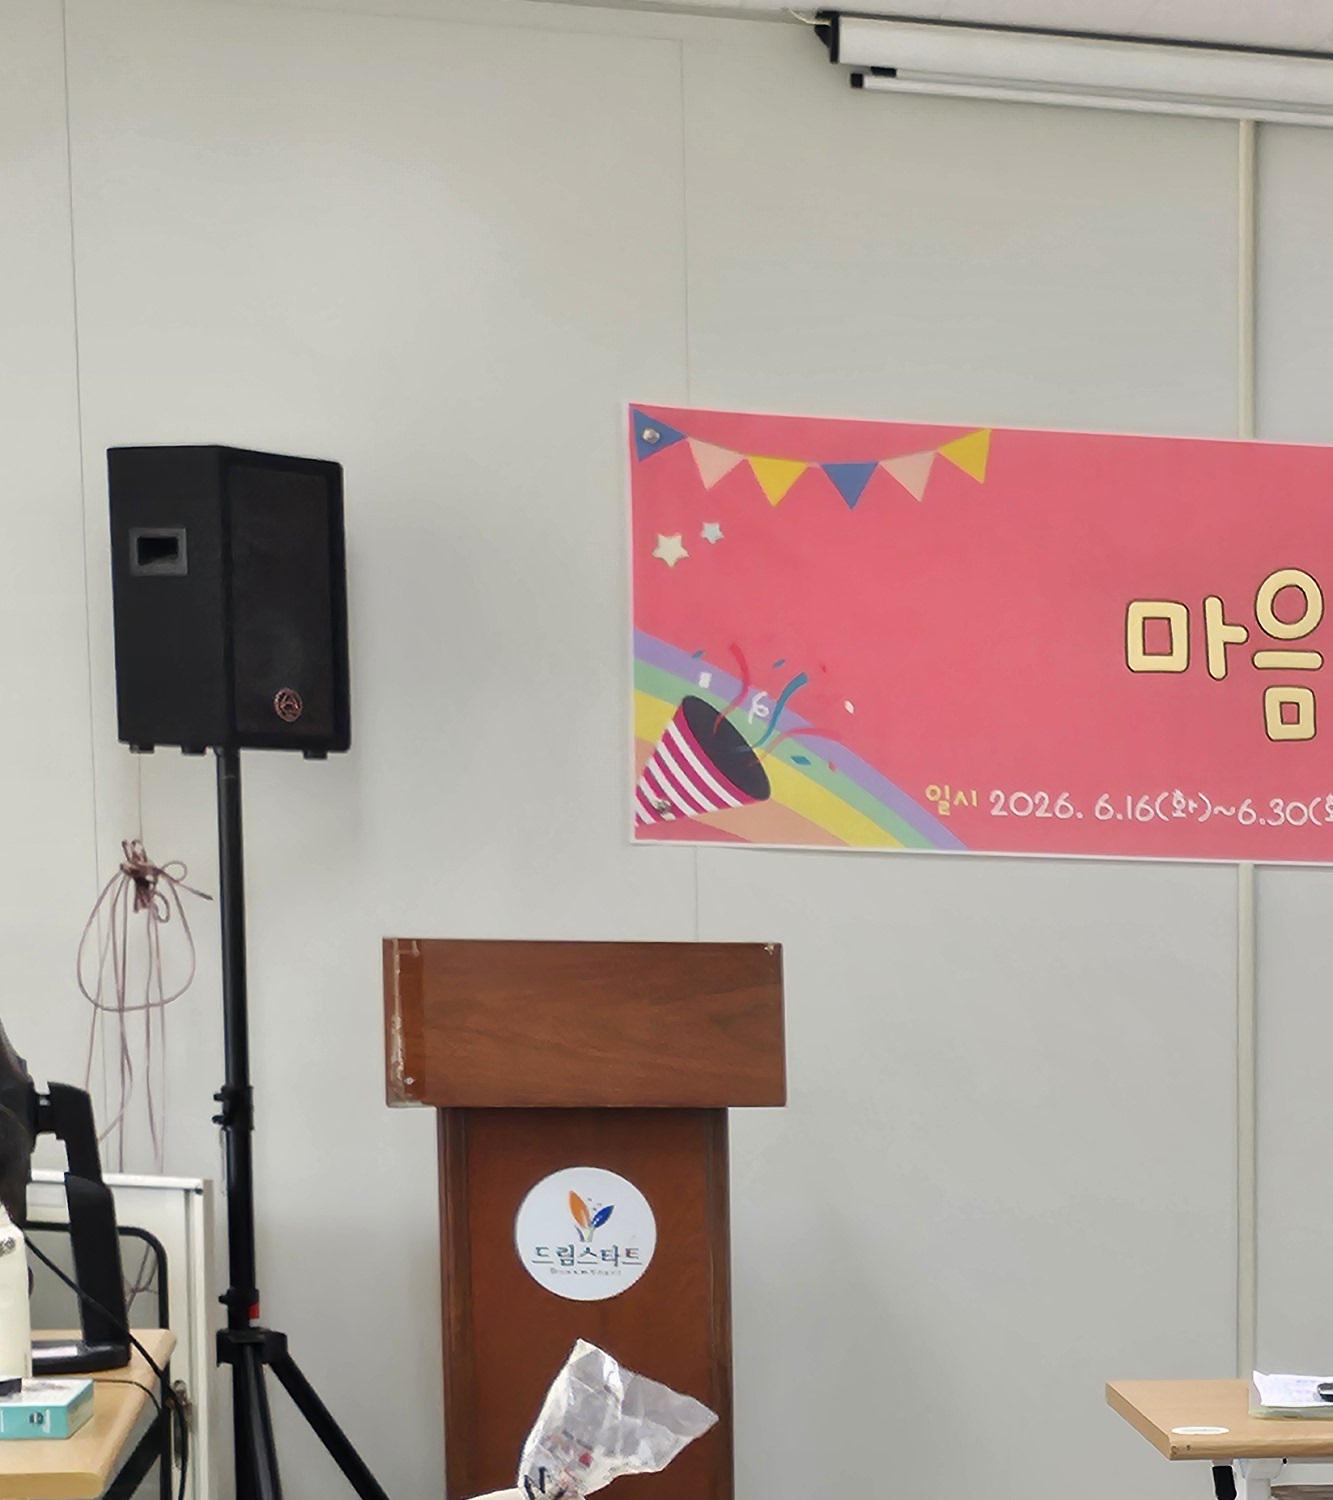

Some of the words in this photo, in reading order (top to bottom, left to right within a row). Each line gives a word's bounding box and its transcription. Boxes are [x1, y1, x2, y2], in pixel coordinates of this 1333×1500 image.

[1125, 567, 1324, 741] 마음
[924, 784, 979, 816] 일시
[989, 790, 1083, 820] 2026.
[531, 1243, 642, 1267] 드림스타트
